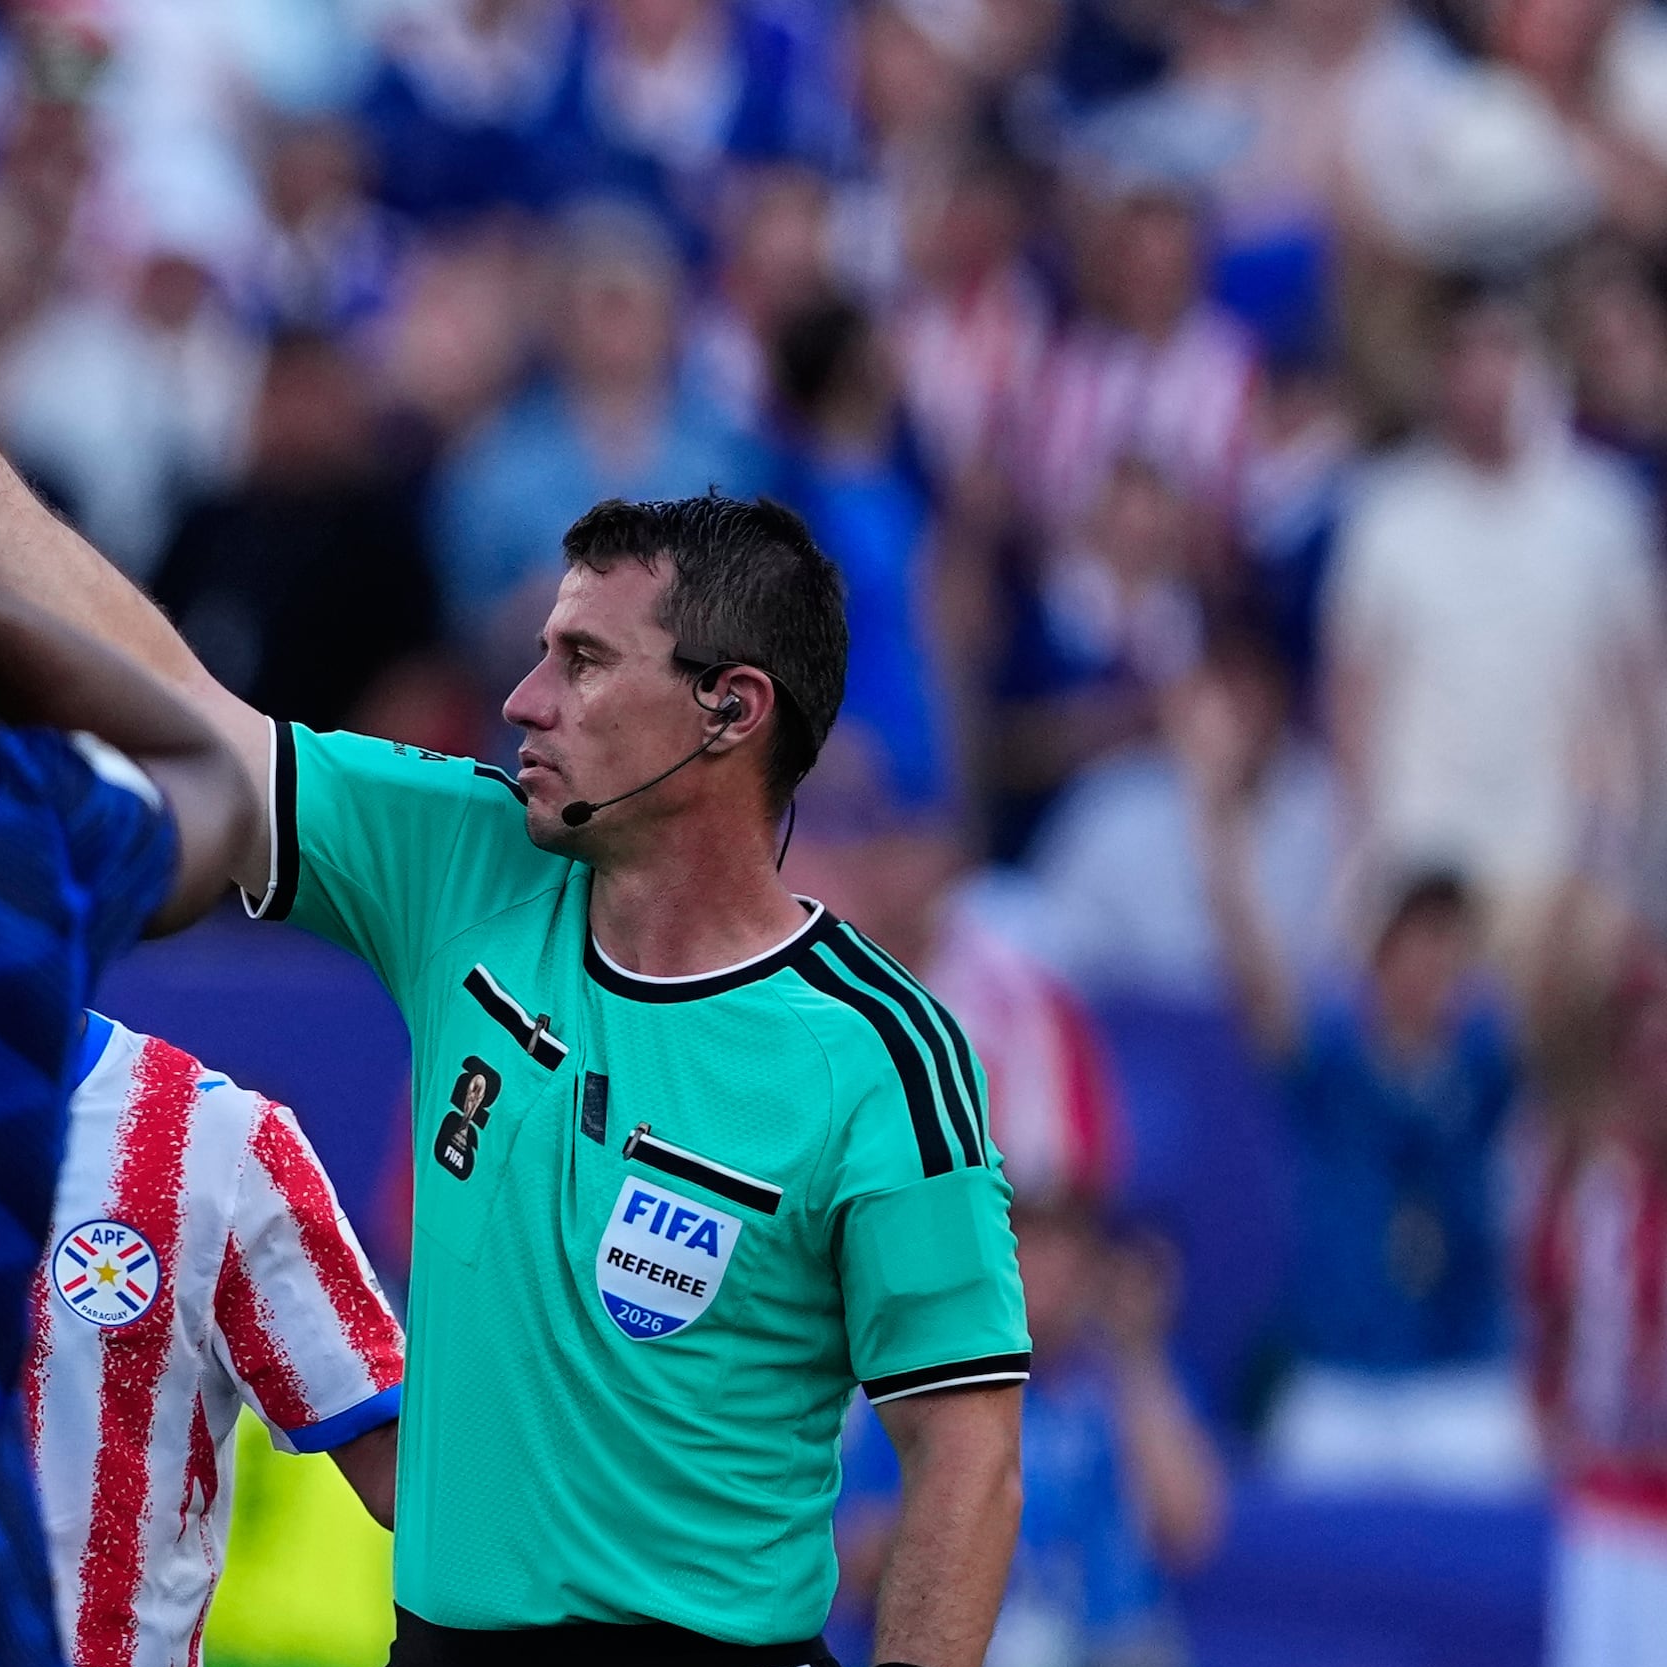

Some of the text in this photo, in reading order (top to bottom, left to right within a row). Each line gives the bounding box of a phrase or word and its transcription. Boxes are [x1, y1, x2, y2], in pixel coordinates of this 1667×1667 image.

[443, 1144, 465, 1170] FIFA
[90, 1228, 126, 1247] APF
[622, 1189, 718, 1259] FIFA
[606, 1246, 708, 1299] REFEREE
[80, 1304, 129, 1322] PARAGUAY
[617, 1303, 664, 1333] 2026
